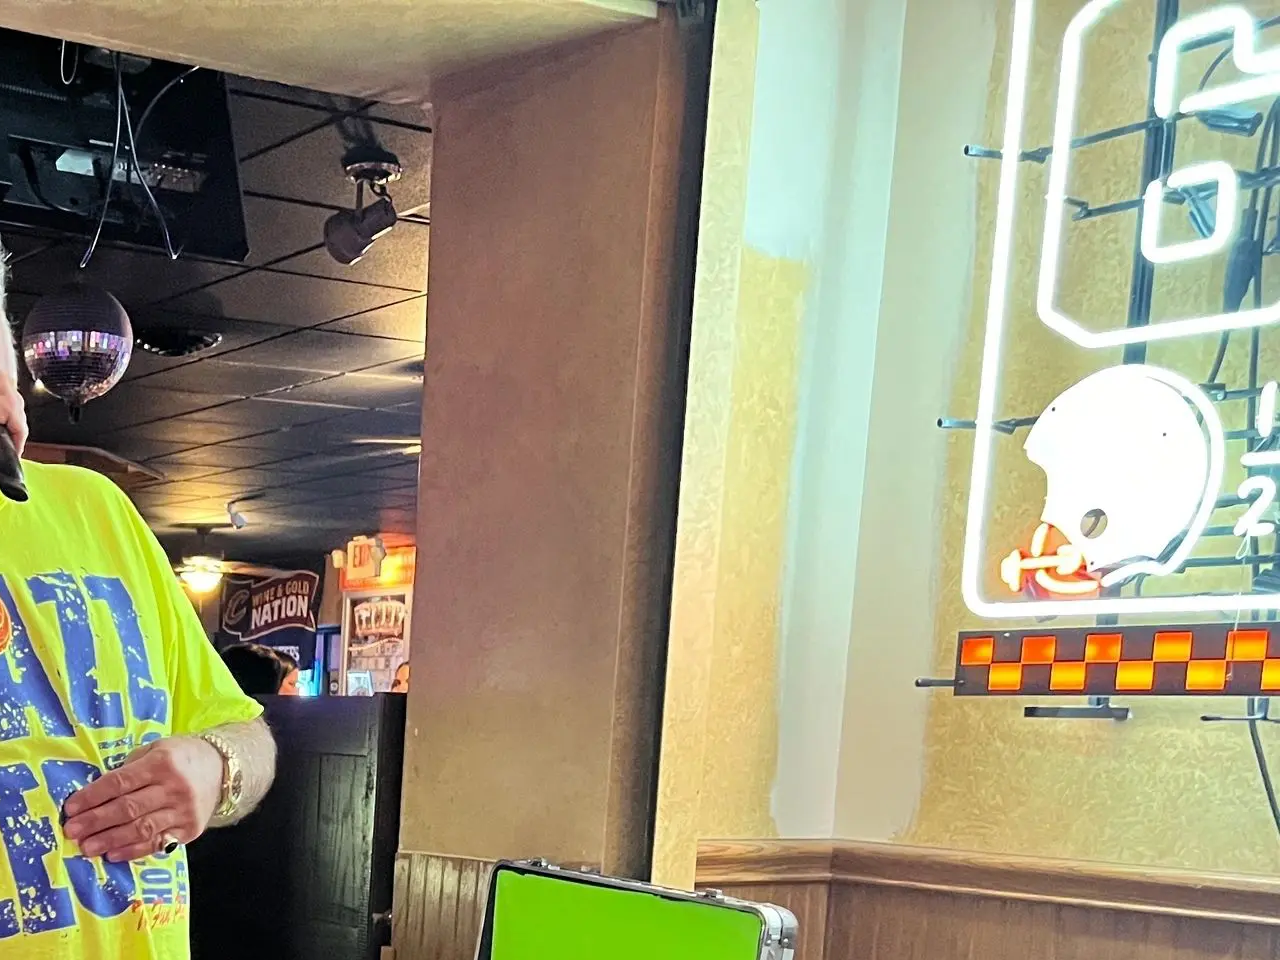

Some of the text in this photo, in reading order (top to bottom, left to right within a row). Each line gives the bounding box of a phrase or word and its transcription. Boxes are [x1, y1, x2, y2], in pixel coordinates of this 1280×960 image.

[252, 587, 276, 607] WINE
[285, 580, 310, 597] GOLD
[251, 595, 309, 630] NATION
